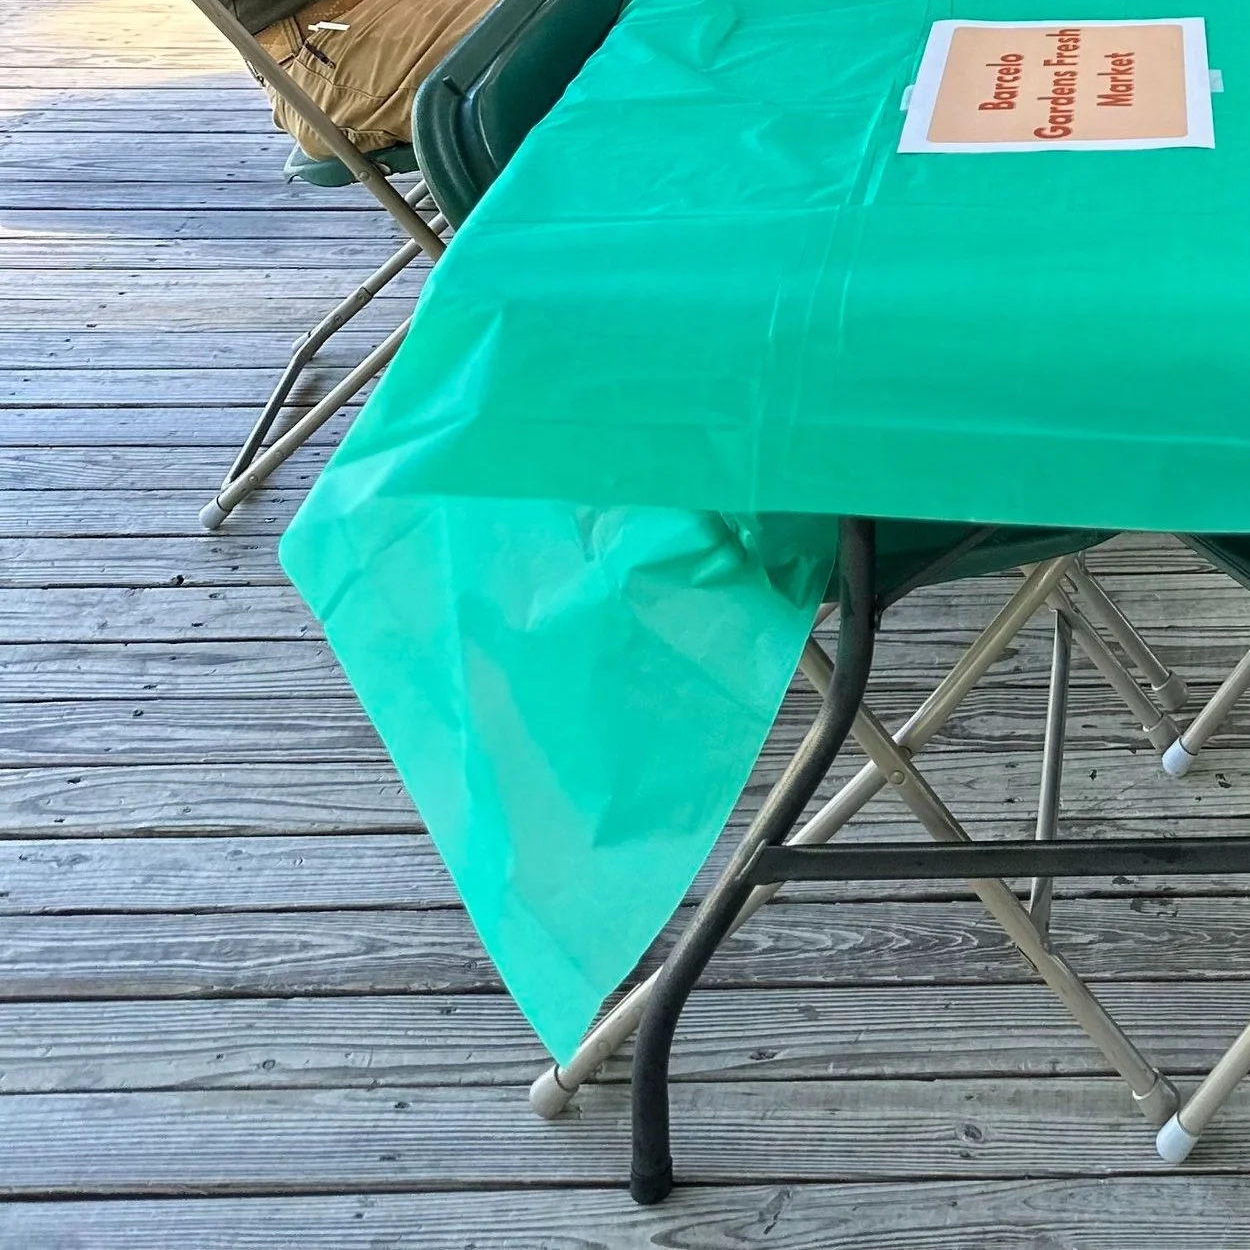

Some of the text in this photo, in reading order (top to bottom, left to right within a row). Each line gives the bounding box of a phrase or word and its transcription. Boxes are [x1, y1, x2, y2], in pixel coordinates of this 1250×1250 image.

[978, 53, 1024, 111] Barcelo
[1033, 28, 1081, 139] Gardens Fresh
[1096, 52, 1135, 107] Market
